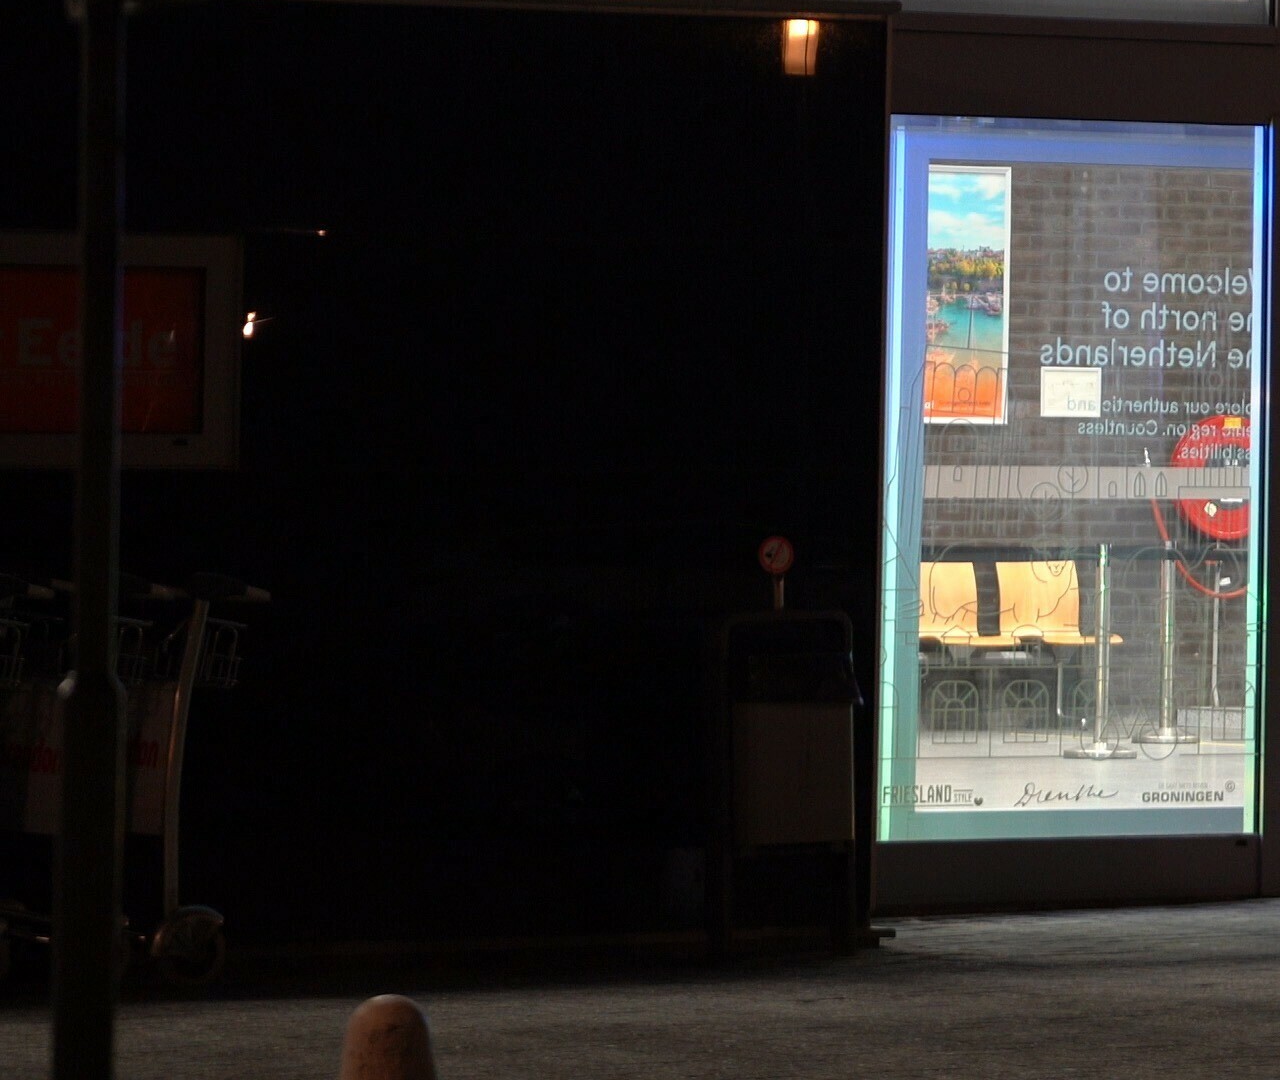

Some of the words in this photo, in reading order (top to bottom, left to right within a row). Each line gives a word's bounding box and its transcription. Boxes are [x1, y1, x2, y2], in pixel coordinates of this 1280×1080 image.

[883, 784, 952, 804] FRIESLAND
[954, 792, 972, 803] STYLE
[1014, 782, 1119, 807] Drenthe
[1142, 790, 1224, 803] GRONINGEN
